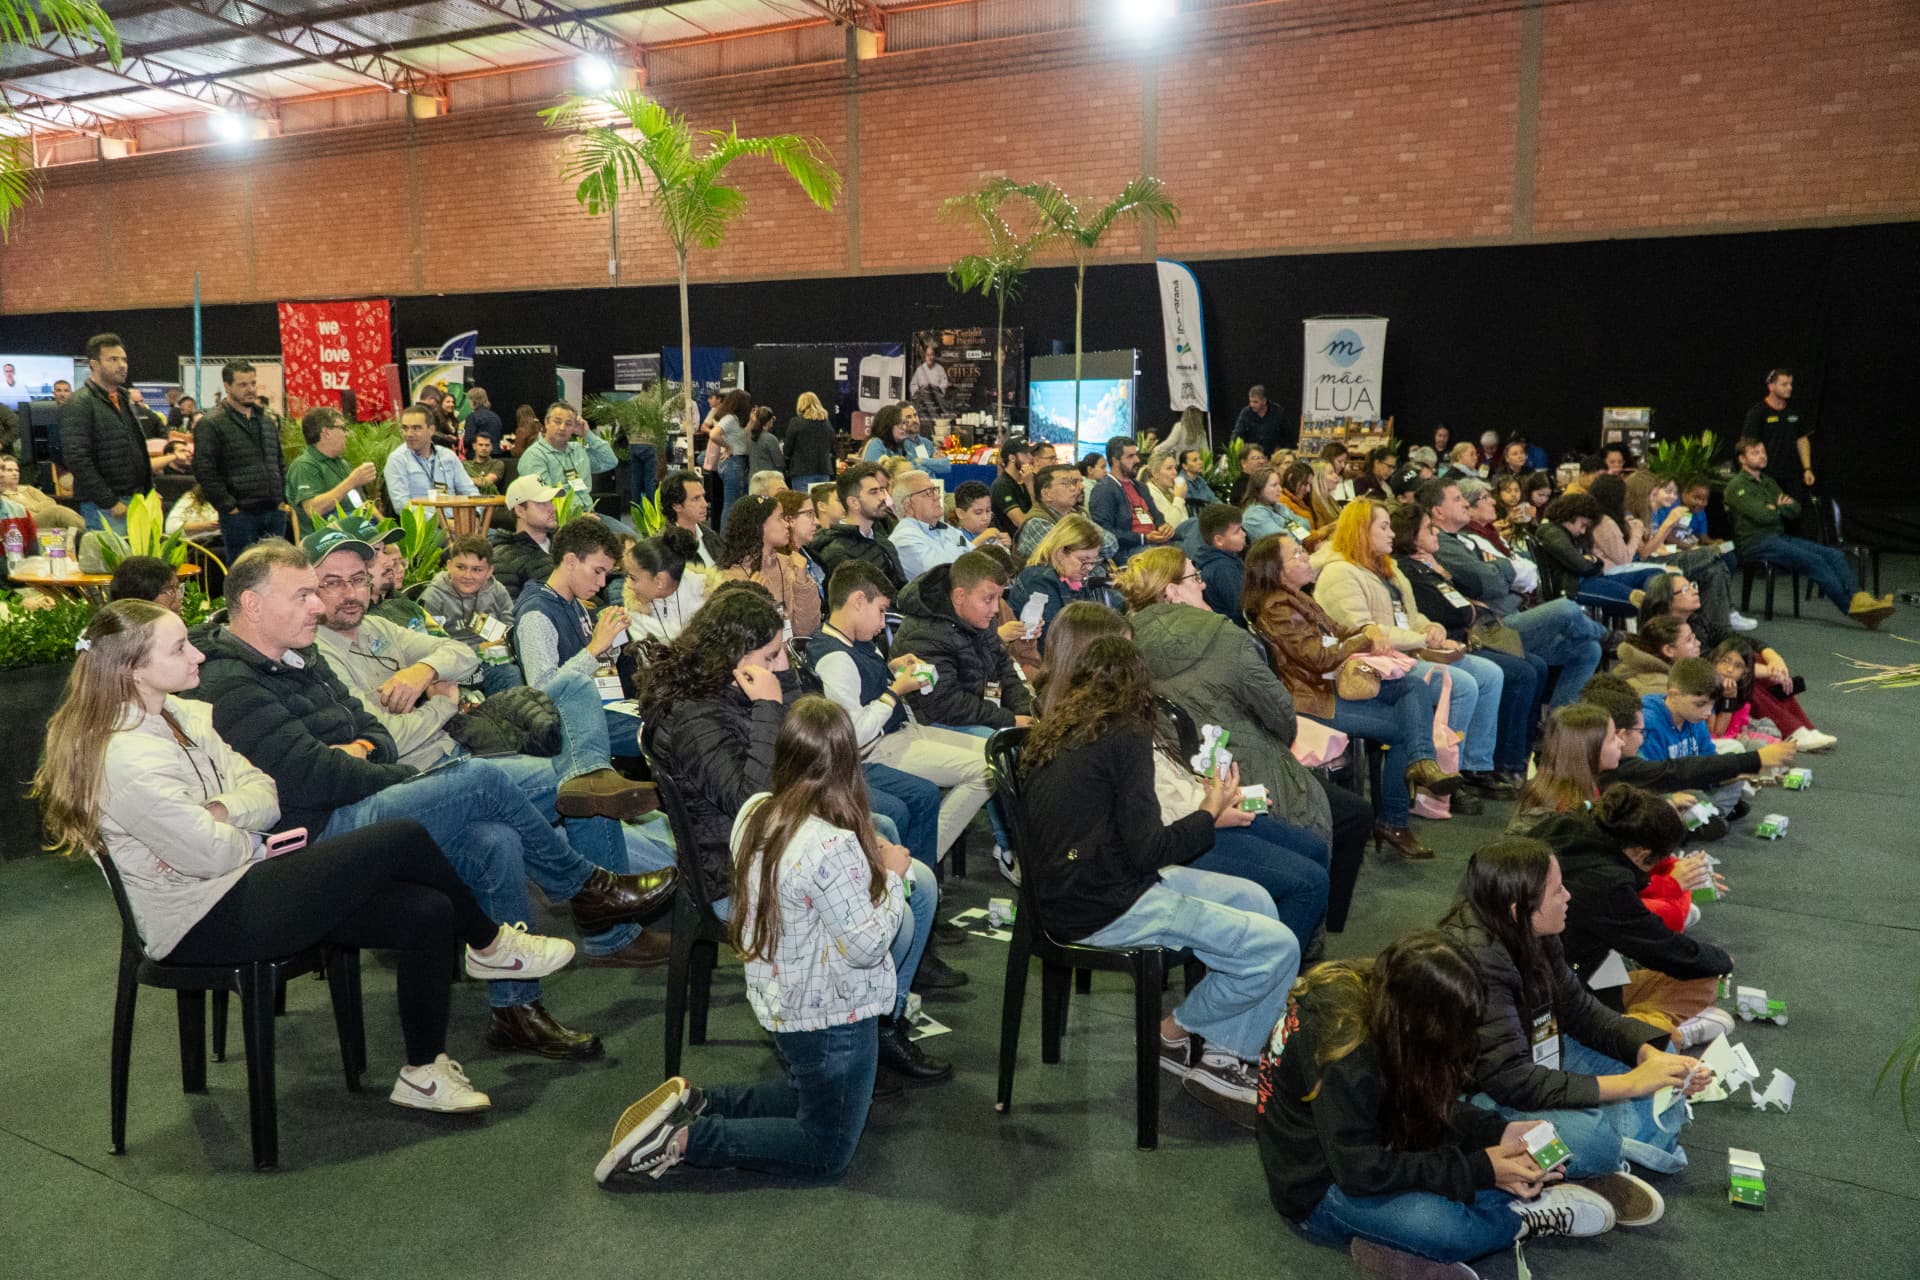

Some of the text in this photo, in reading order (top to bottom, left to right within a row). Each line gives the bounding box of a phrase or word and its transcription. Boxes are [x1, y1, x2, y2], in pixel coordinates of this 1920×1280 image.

[319, 321, 339, 335] we
[320, 344, 350, 362] love
[321, 372, 350, 390] BLZ
[1319, 371, 1368, 385] mãe
[1315, 387, 1374, 412] LUA
